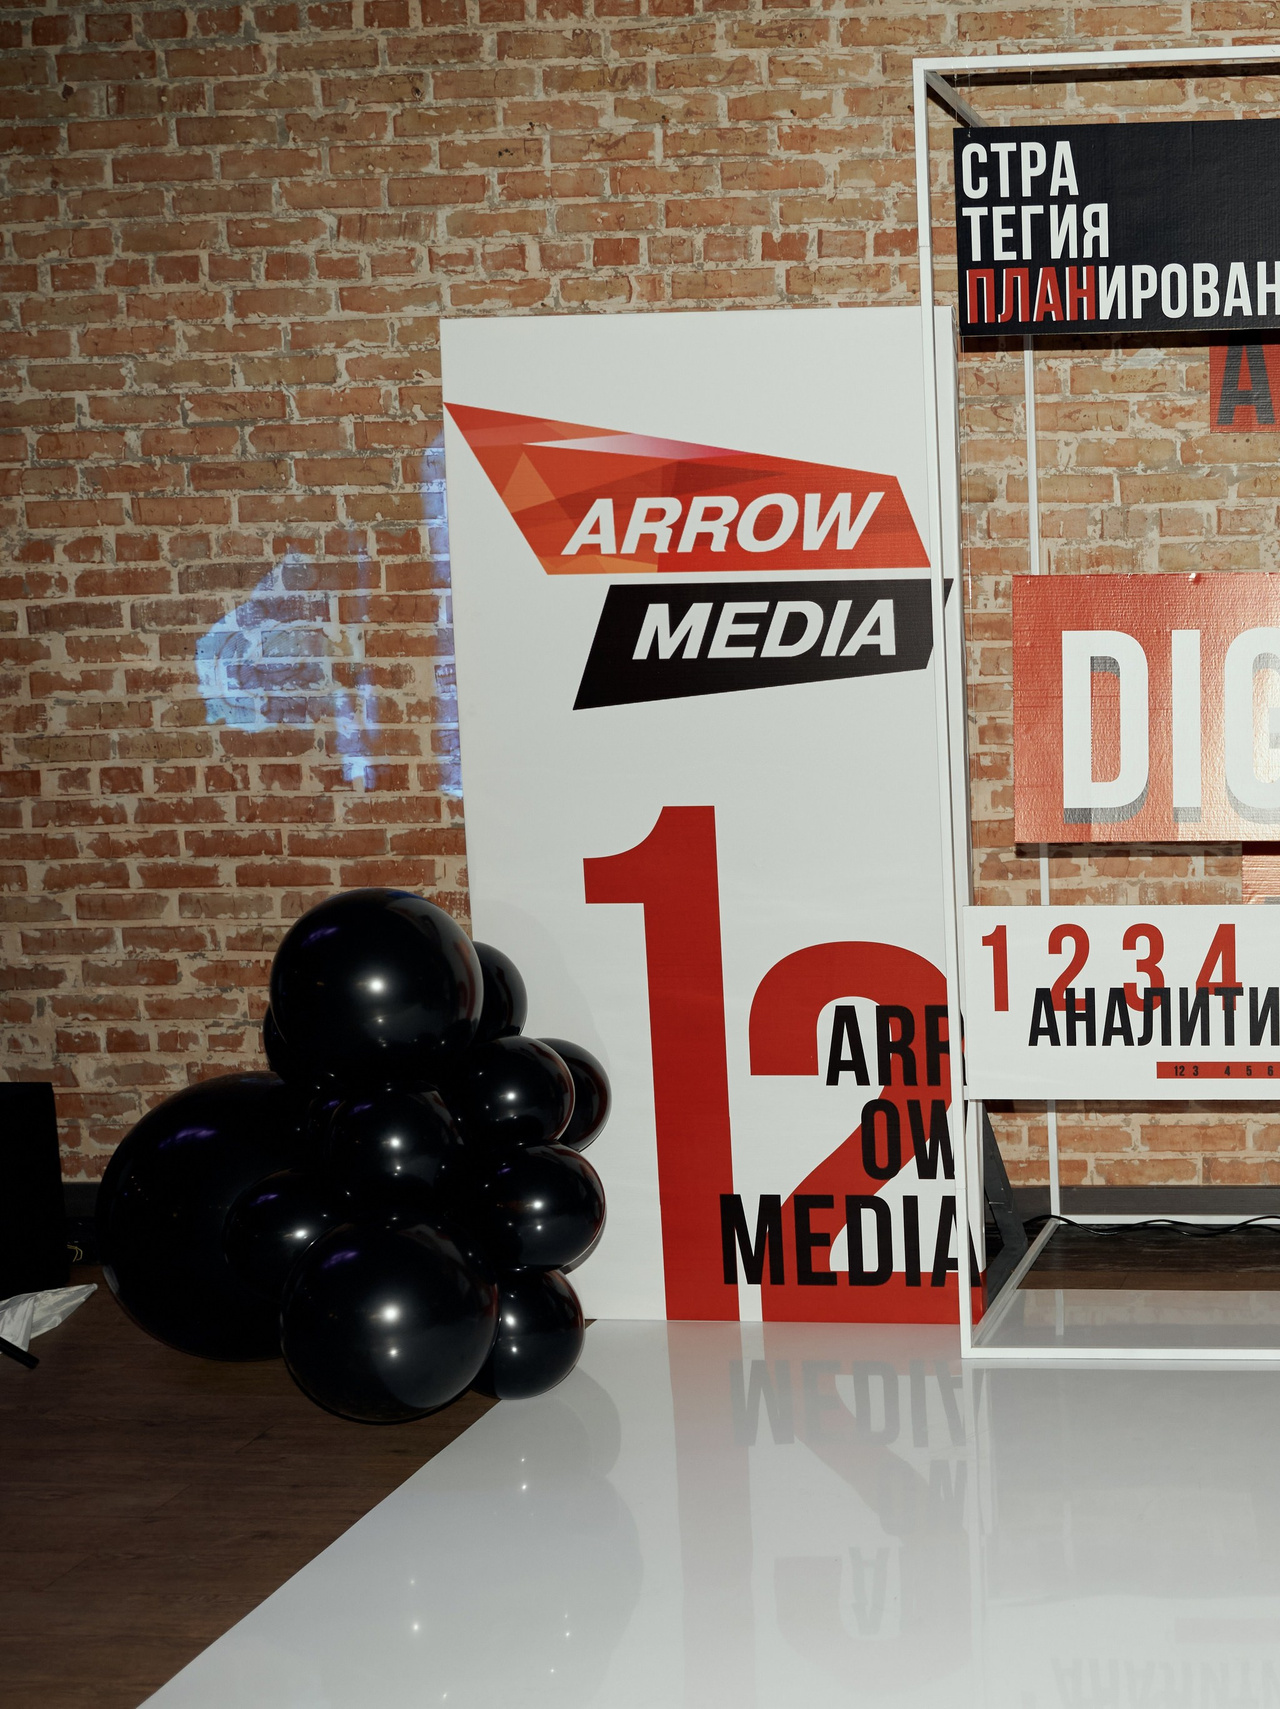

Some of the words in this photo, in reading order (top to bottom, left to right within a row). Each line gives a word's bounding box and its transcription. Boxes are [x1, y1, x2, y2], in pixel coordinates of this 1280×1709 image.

[961, 140, 1079, 199] СТРА
[962, 203, 1110, 262] ТЕГИЯ
[561, 491, 884, 555] ARROW
[632, 599, 896, 660] MEDIA
[583, 805, 983, 1324] 12
[719, 1193, 980, 1288] MEDIA
